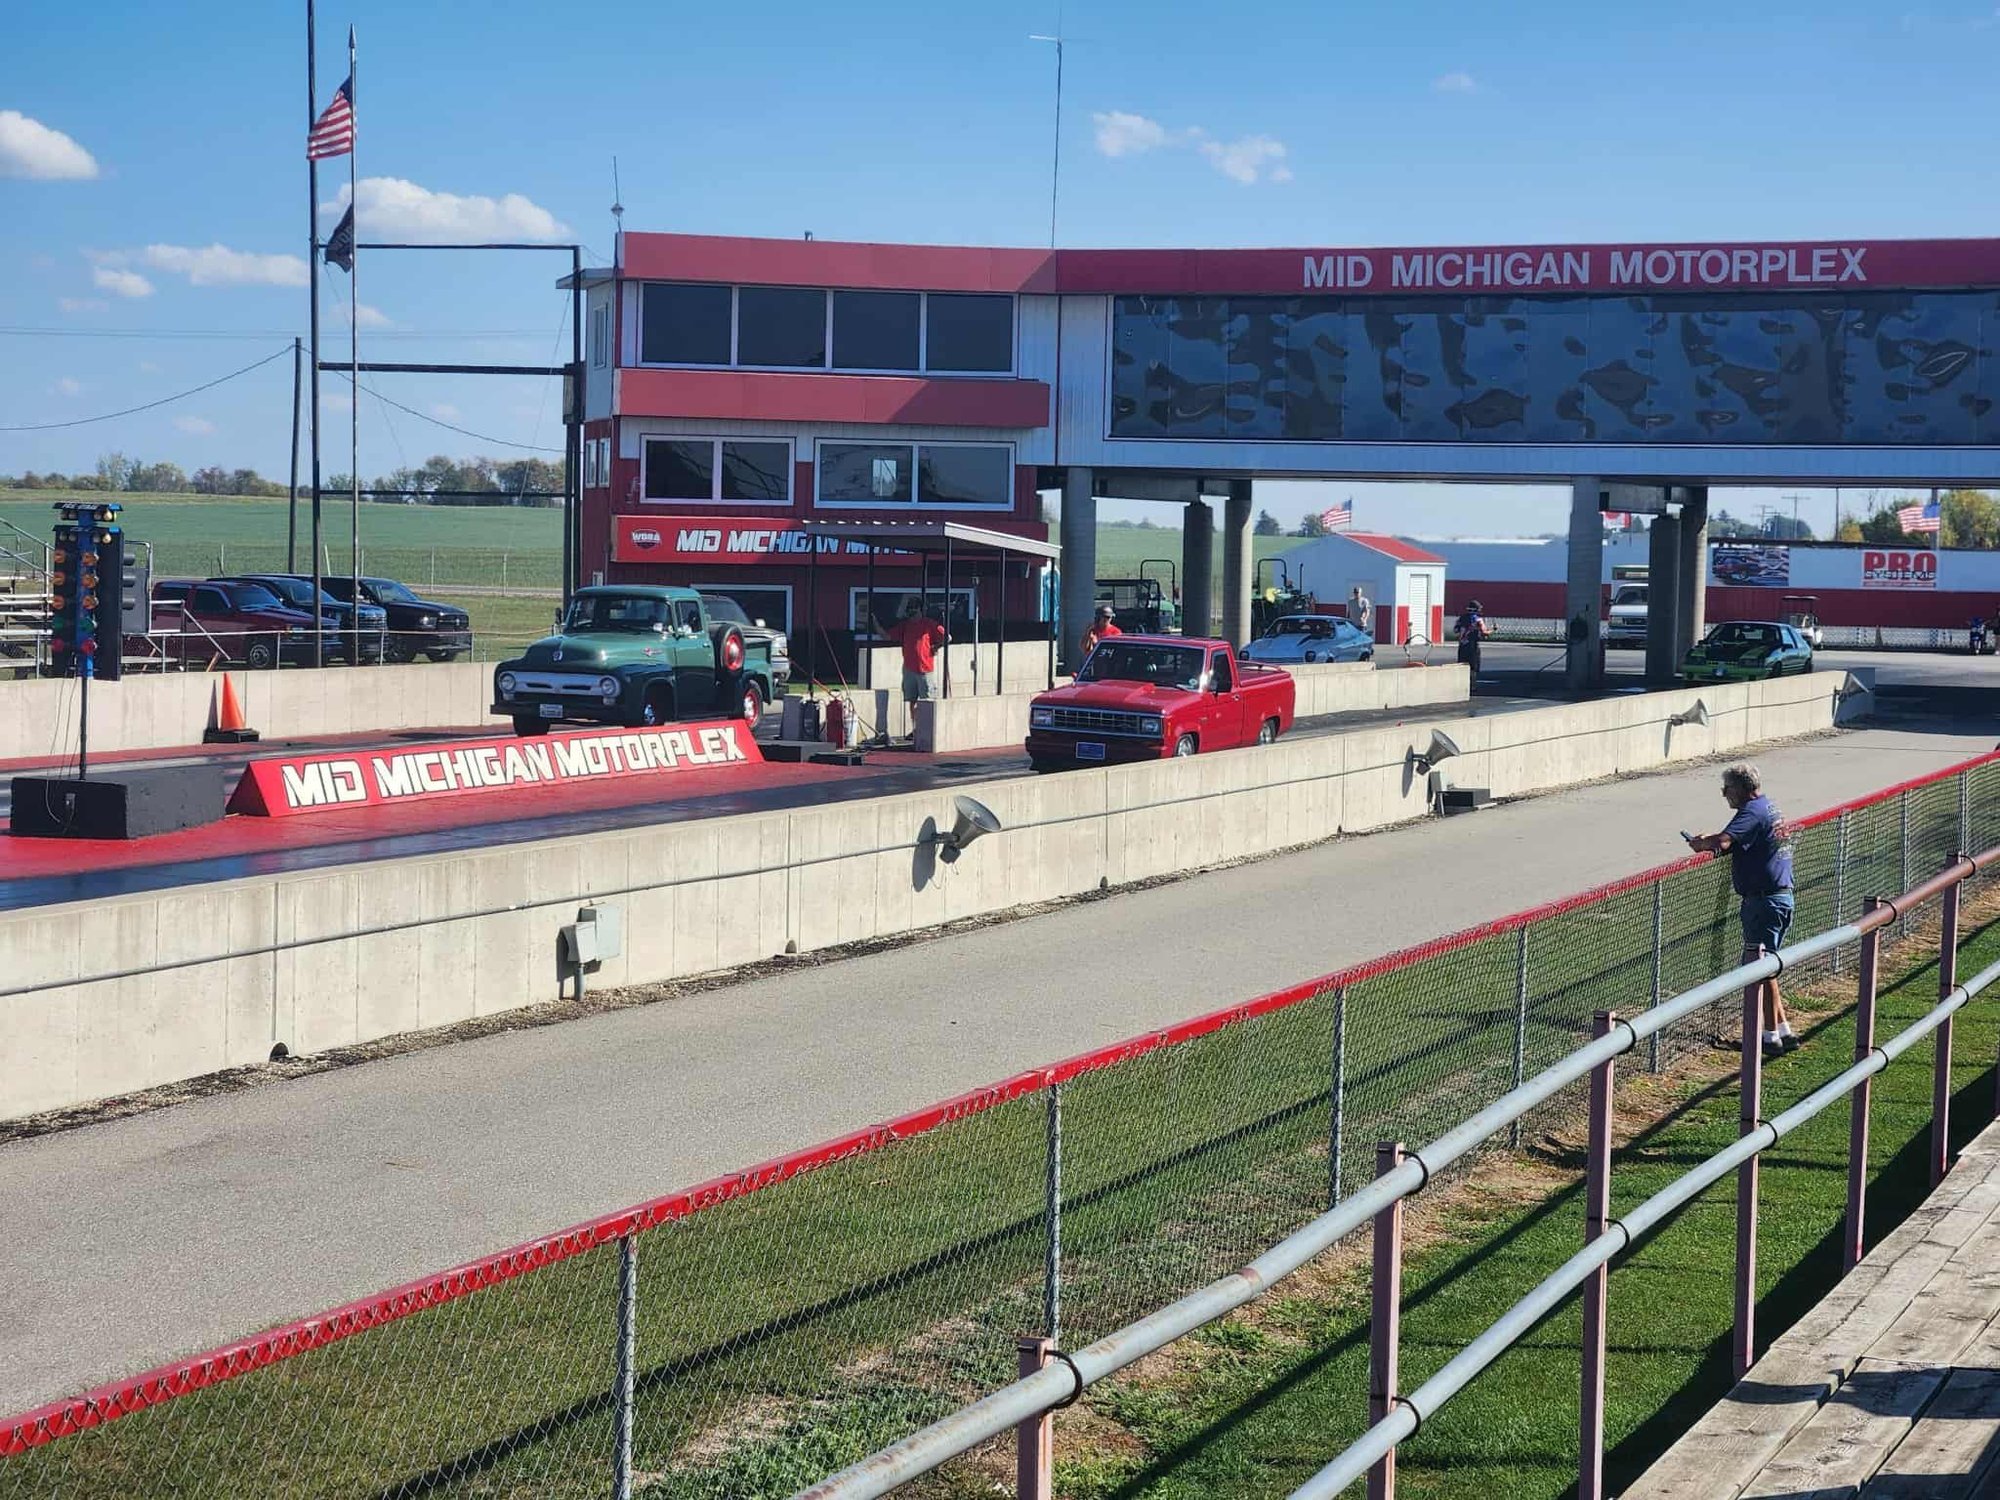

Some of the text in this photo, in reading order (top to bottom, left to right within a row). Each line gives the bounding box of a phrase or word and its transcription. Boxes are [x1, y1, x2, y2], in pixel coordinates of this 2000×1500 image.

[1303, 248, 1867, 287] MID MICHIGAN MOTORPLEX
[676, 529, 721, 552] MID
[1864, 552, 1937, 572] PRO
[281, 727, 747, 808] MID MICHIGAN MOTORPLEX
